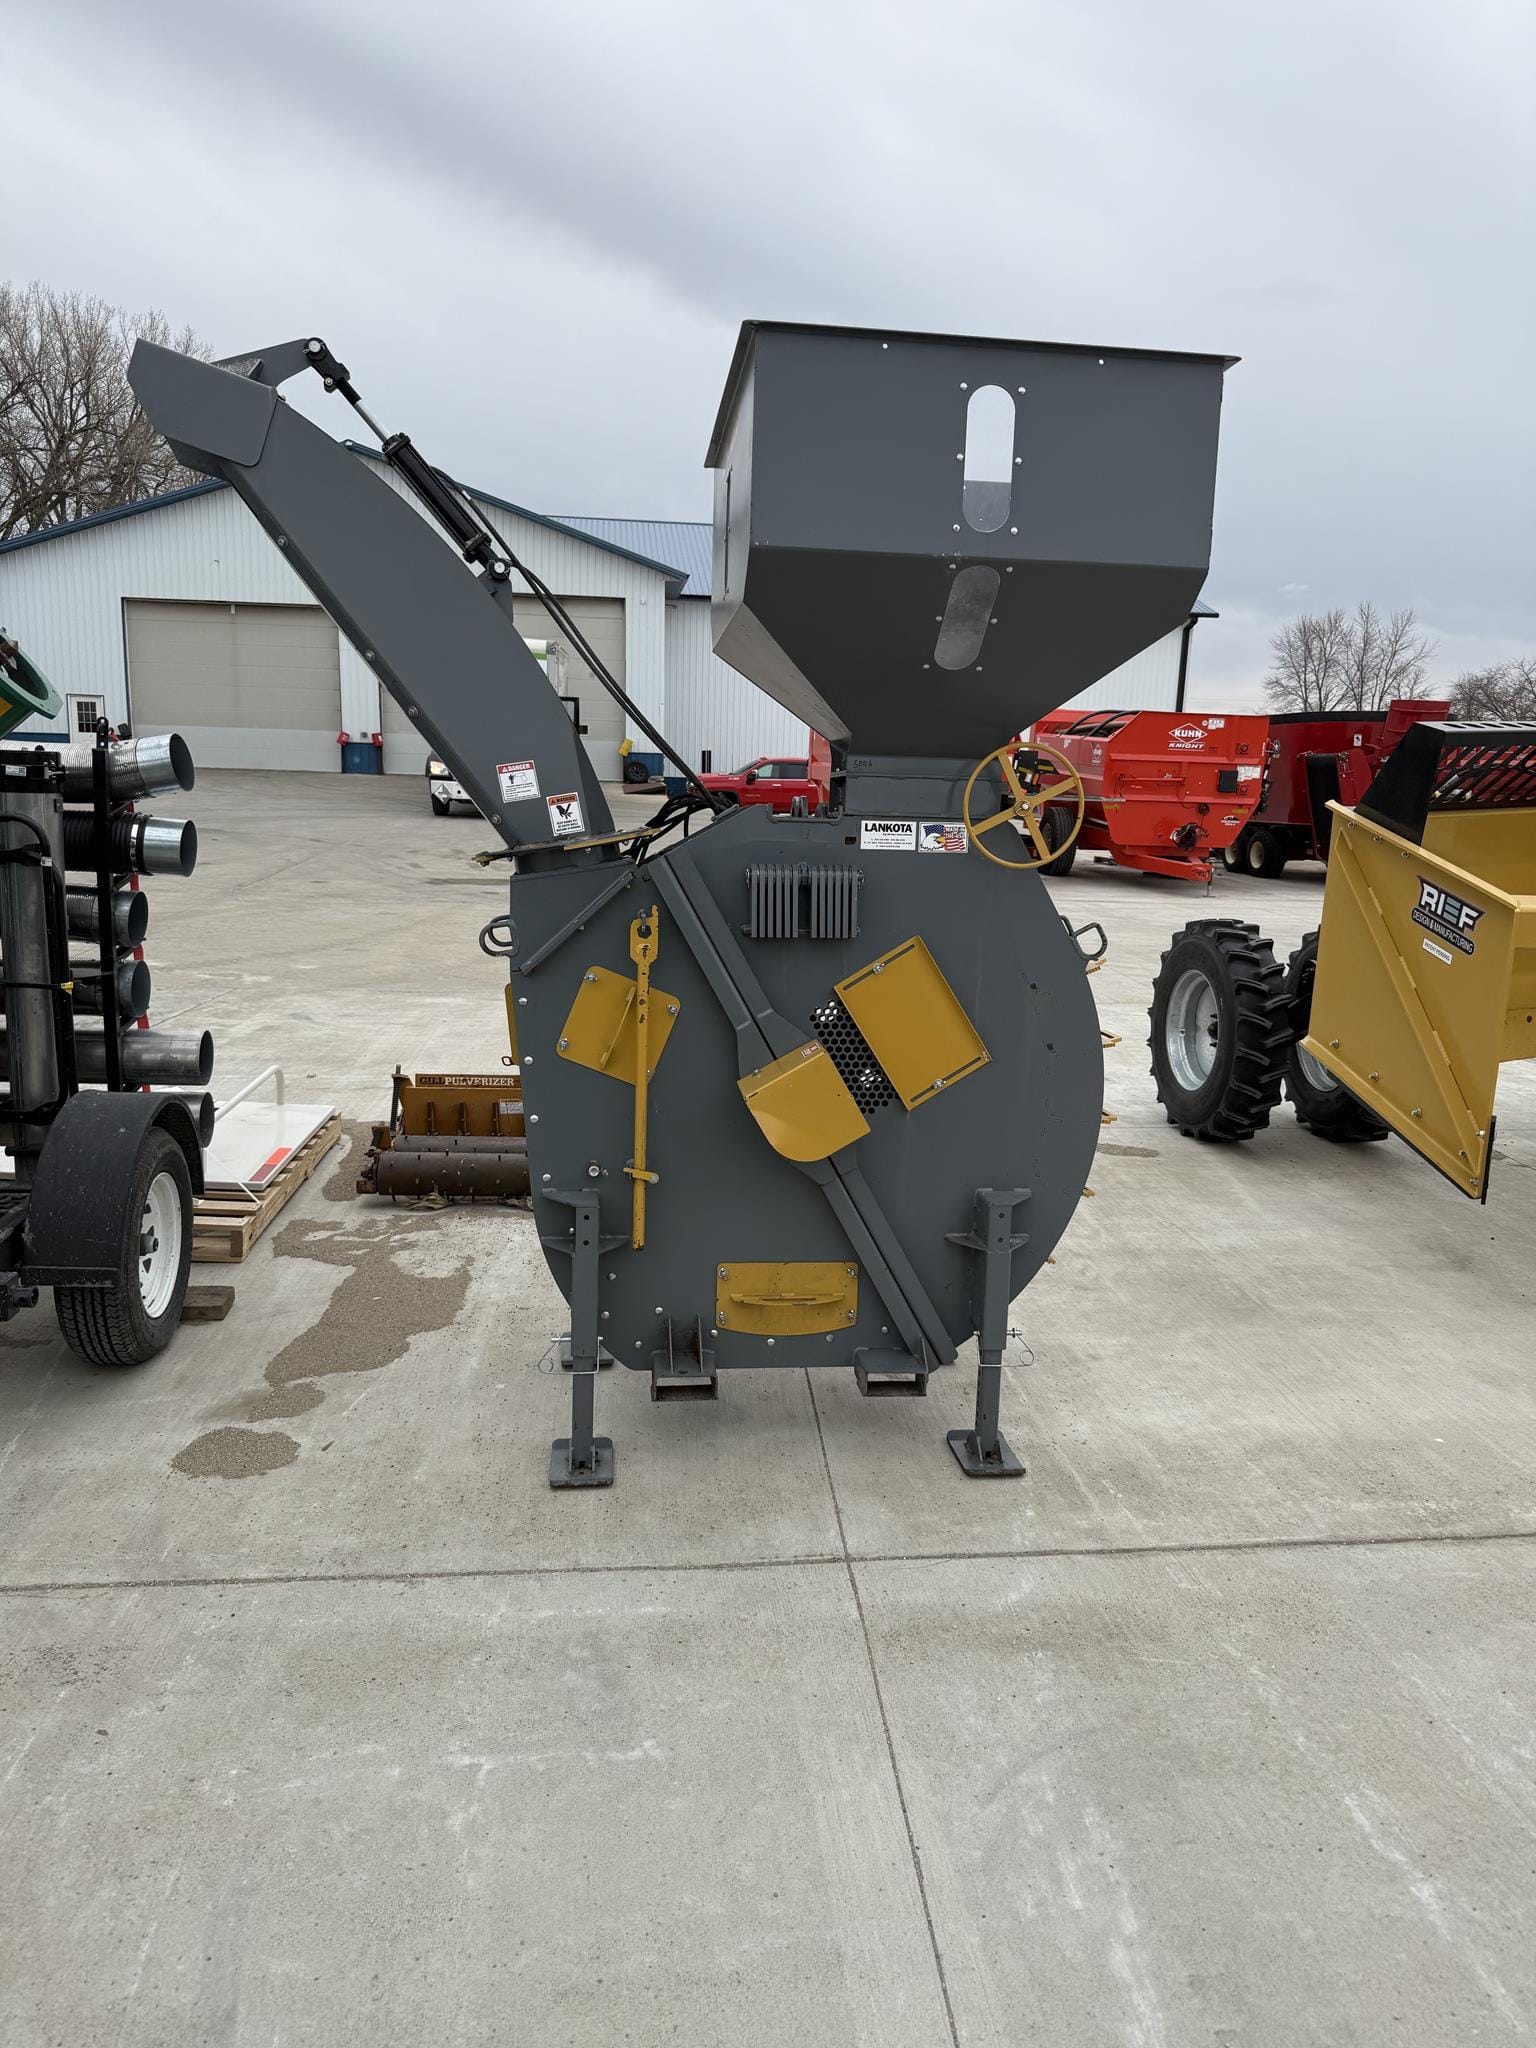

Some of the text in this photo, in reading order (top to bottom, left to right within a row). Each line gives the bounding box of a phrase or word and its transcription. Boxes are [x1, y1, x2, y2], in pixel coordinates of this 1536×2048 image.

[1174, 729, 1202, 738] KUHN
[865, 823, 912, 833] LANKOTA
[1420, 883, 1479, 929] RIEF
[1413, 910, 1430, 927] DESIGN
[1434, 922, 1473, 953] MANUFACTURING
[444, 1077, 514, 1086] PULVERIZER
